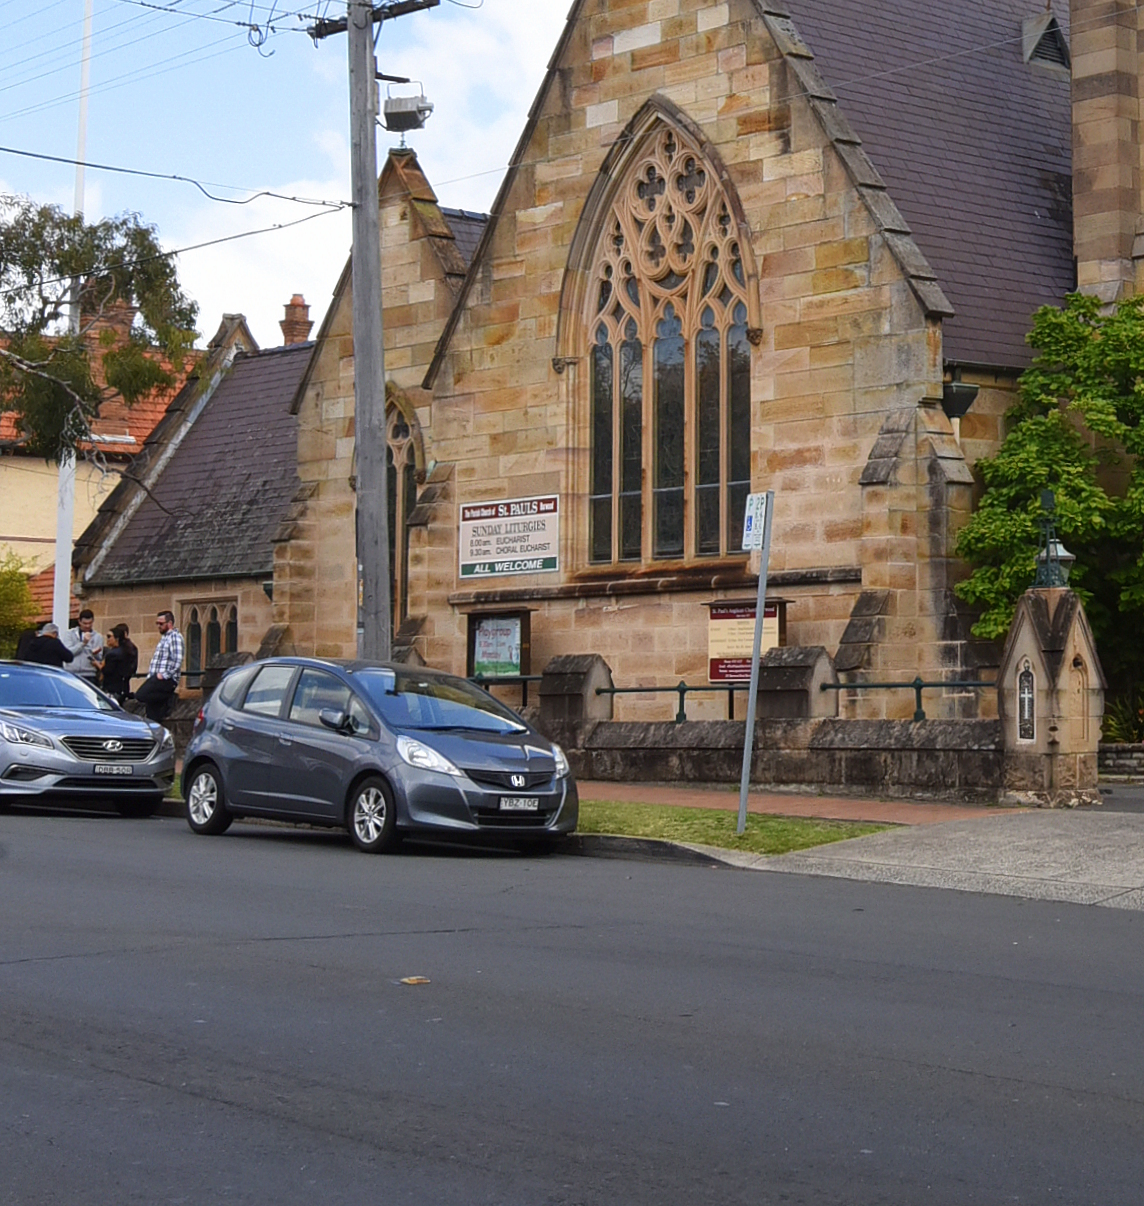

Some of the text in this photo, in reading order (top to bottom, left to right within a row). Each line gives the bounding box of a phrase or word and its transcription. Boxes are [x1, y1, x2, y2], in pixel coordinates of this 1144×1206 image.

[510, 501, 538, 515] PAULS
[472, 520, 546, 535] SUNDAY LITURGIES
[496, 535, 530, 545] EUCHARIST
[496, 546, 518, 555] CHORAL
[519, 543, 551, 553] EUCHARIST
[473, 559, 544, 573] ALL WELCOME
